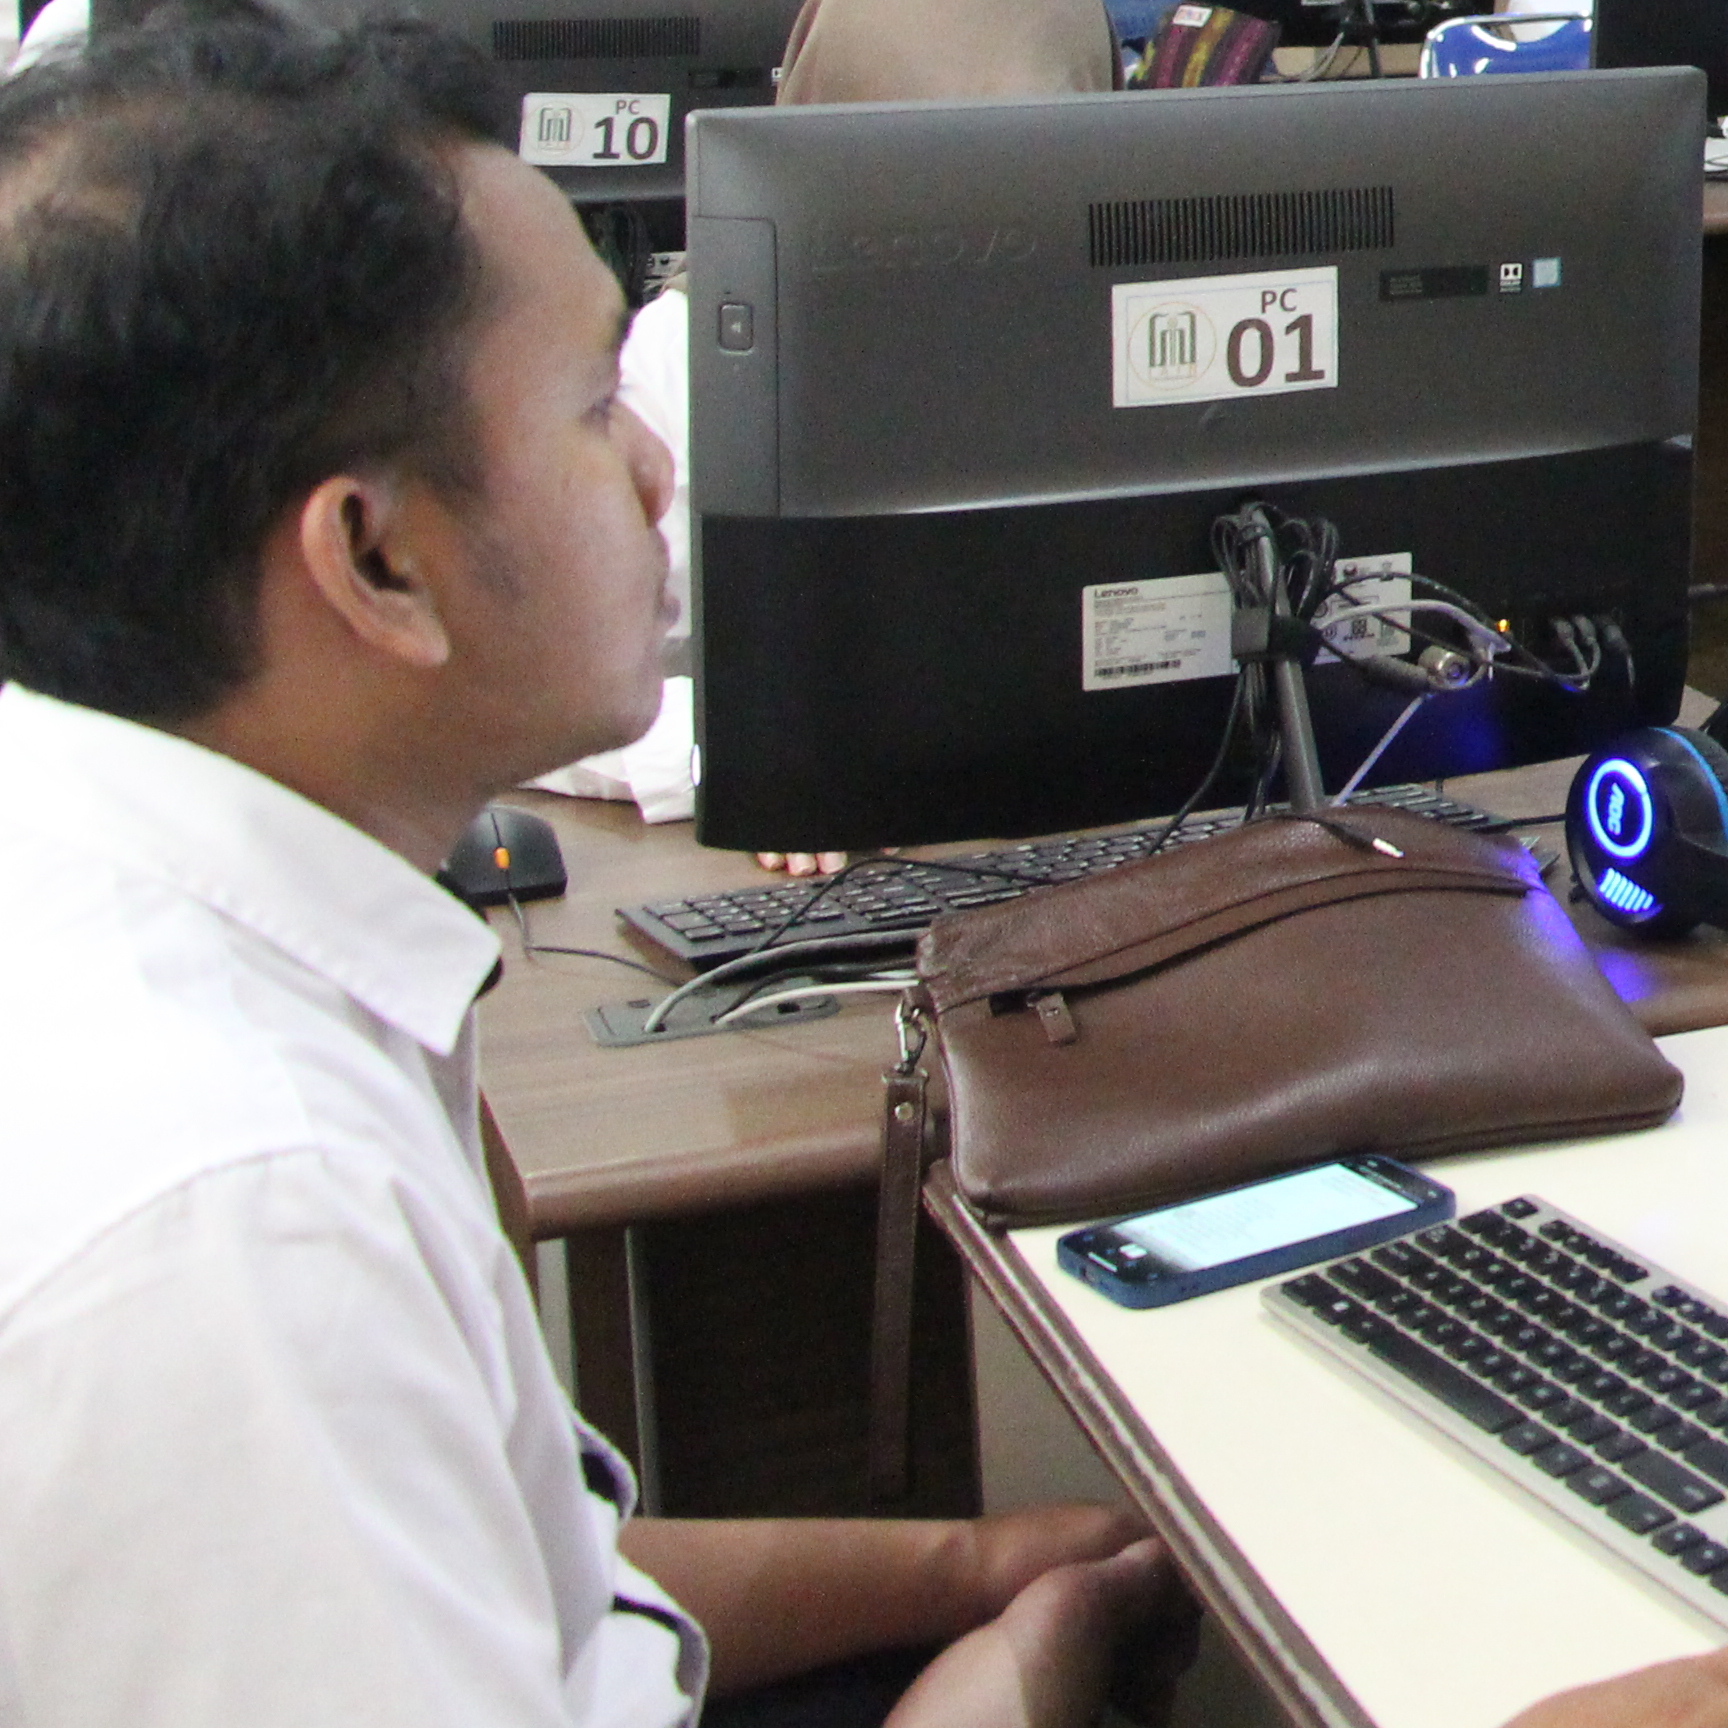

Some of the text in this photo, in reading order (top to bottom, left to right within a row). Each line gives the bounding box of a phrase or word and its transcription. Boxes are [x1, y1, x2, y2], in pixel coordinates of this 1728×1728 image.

[615, 100, 641, 115] PC
[592, 116, 659, 160] 10
[1261, 288, 1297, 314] PC
[1226, 313, 1326, 388] 01
[1094, 586, 1139, 599] Lenovo
